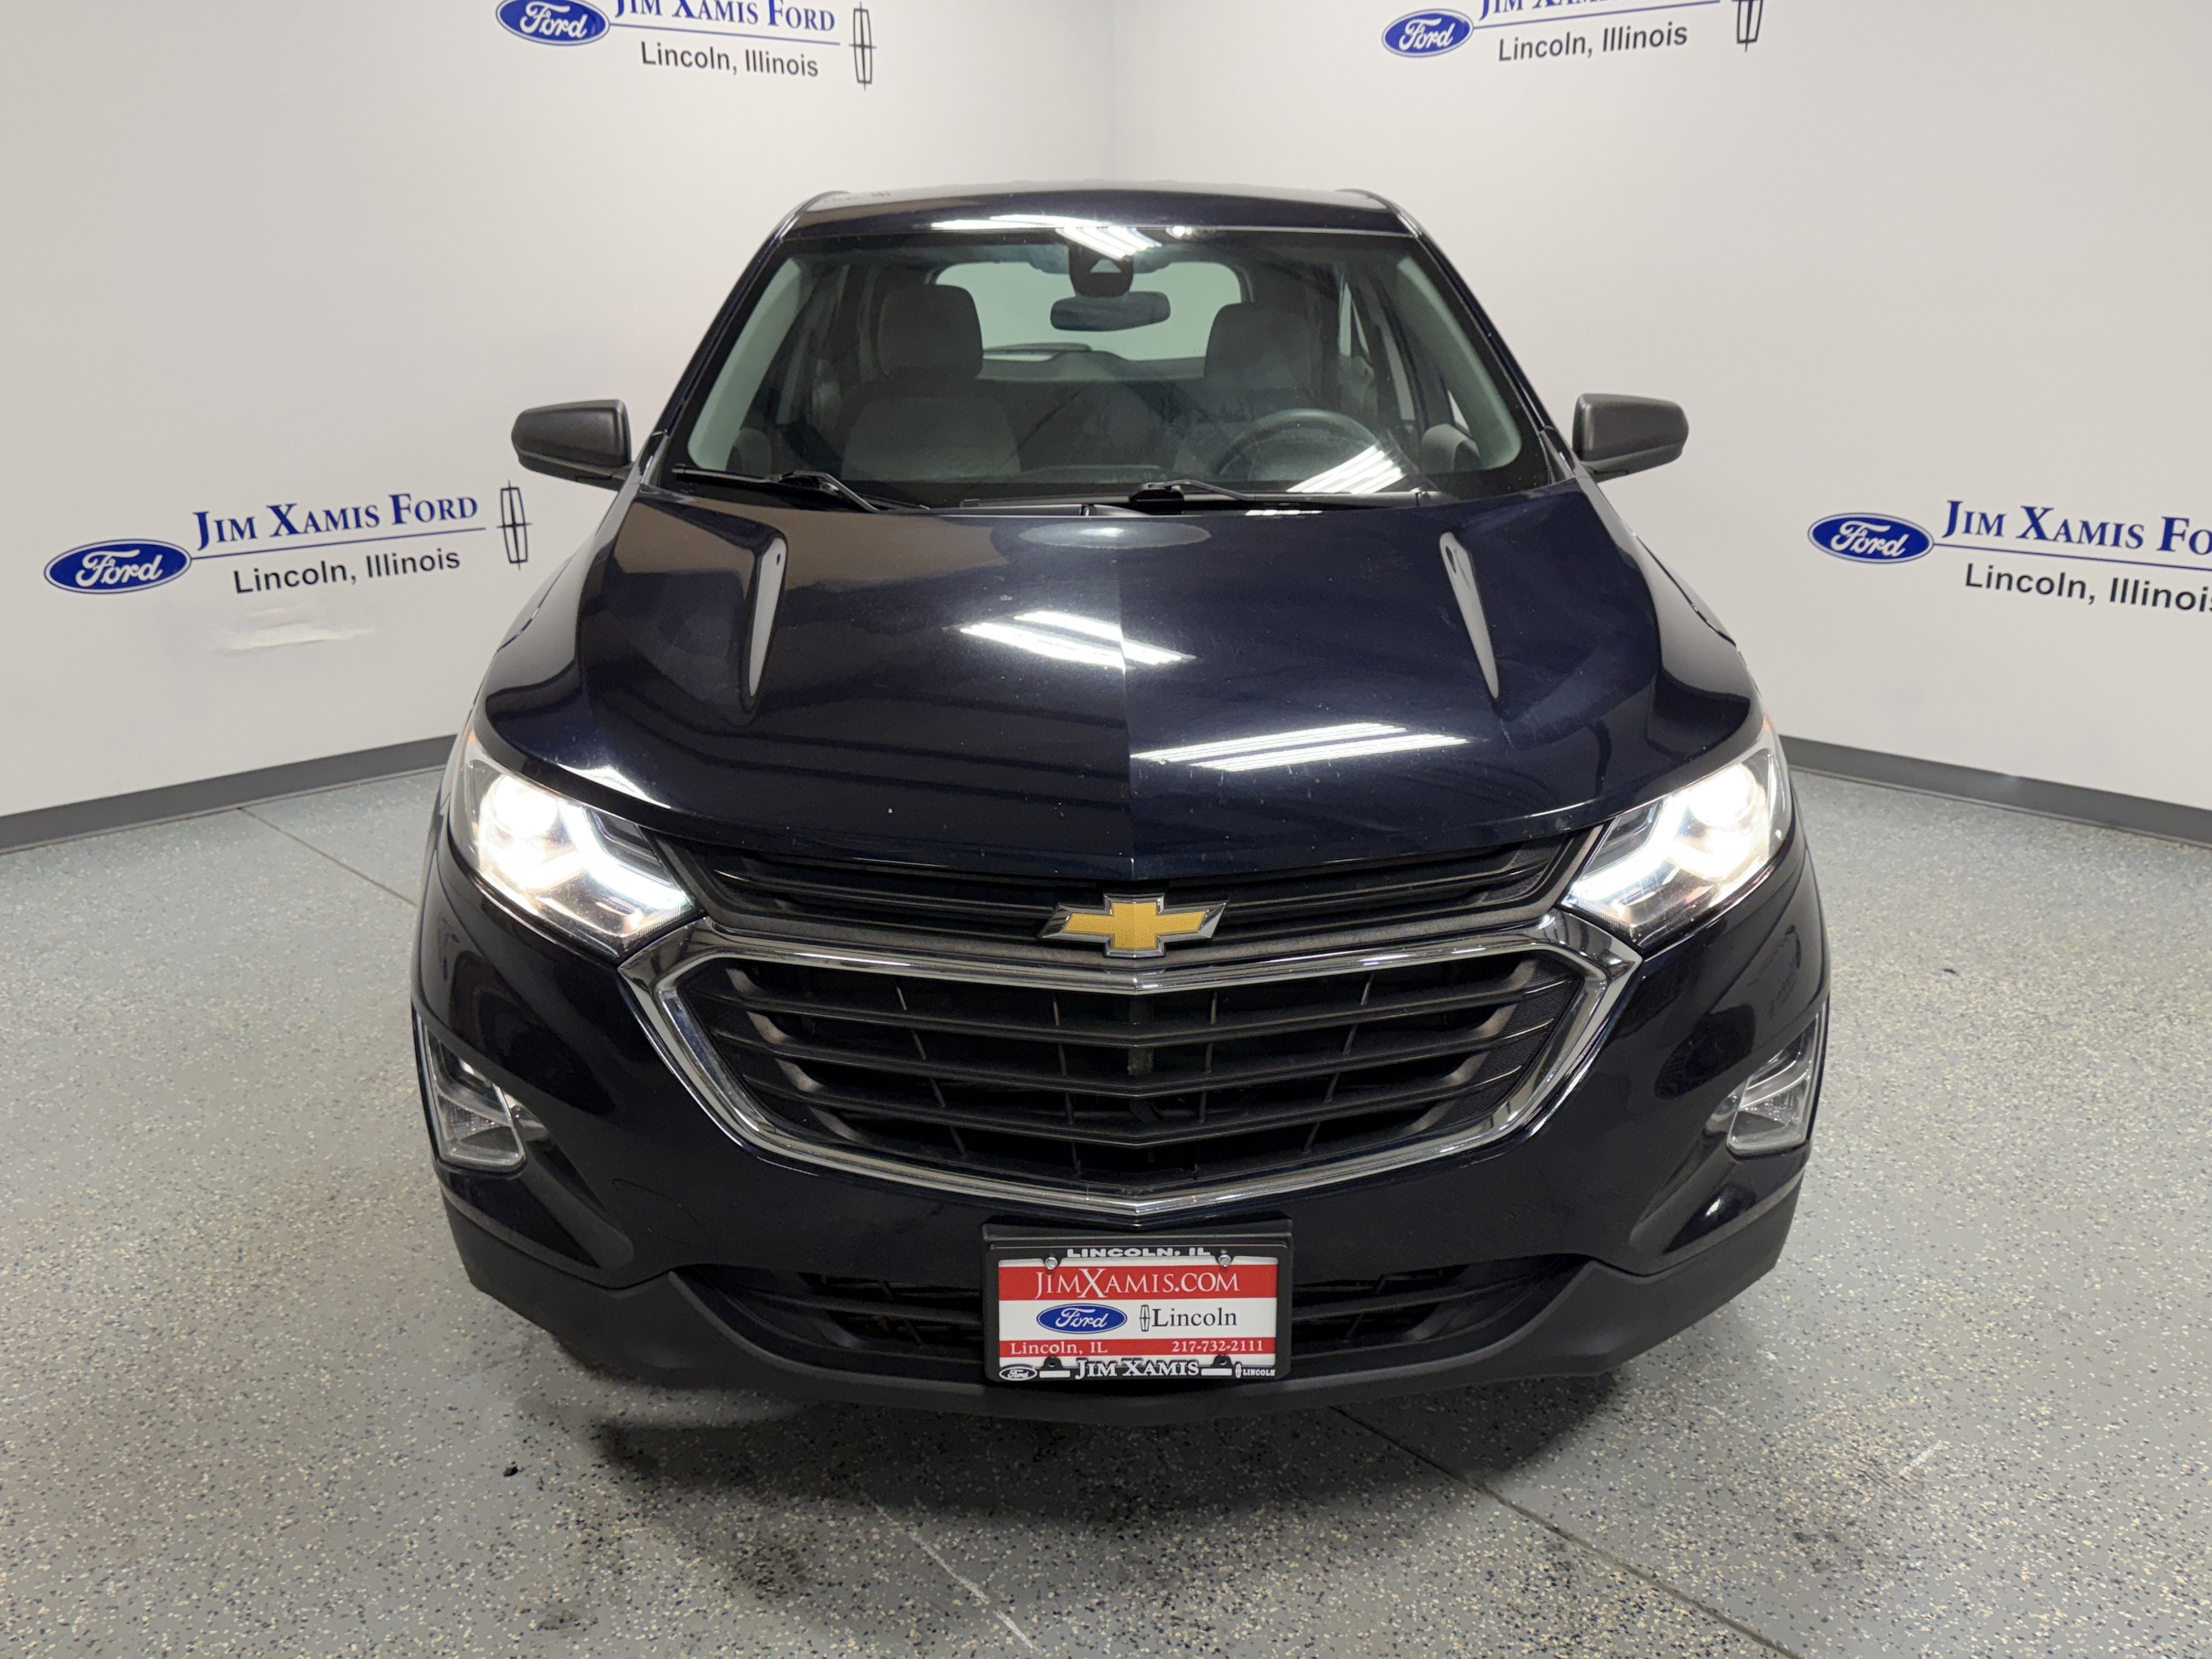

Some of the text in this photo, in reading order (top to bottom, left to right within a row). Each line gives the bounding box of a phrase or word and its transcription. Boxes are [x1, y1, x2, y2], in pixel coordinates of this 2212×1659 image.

[519, 2, 588, 39] Ford
[672, 0, 758, 24] XAMIS
[768, 0, 835, 31] FORD
[1398, 18, 1455, 51] Ford
[1499, 21, 1688, 61] Lincoln, Illinois
[641, 41, 819, 77] Lincoln, Illinois
[193, 493, 478, 551] JIM XAMIS FORD
[1830, 520, 1909, 557] Ford
[1942, 500, 2006, 538] JIM
[2016, 506, 2145, 549] XAMIS
[75, 549, 163, 587] Ford
[233, 548, 461, 594] Lincoln, Illinois
[1966, 563, 2212, 612] Lincoln, Illinoi
[1067, 1247, 1211, 1257] LINCOLN, IL
[1055, 1307, 1238, 1328] Ford Lincoln
[1011, 1341, 1108, 1356] Lincoln, IL
[1172, 1340, 1263, 1352] 217-732-2111
[1008, 1369, 1029, 1378] Ford
[1075, 1358, 1200, 1380] JIM XAMIS
[1242, 1368, 1276, 1377] LINCOLN
